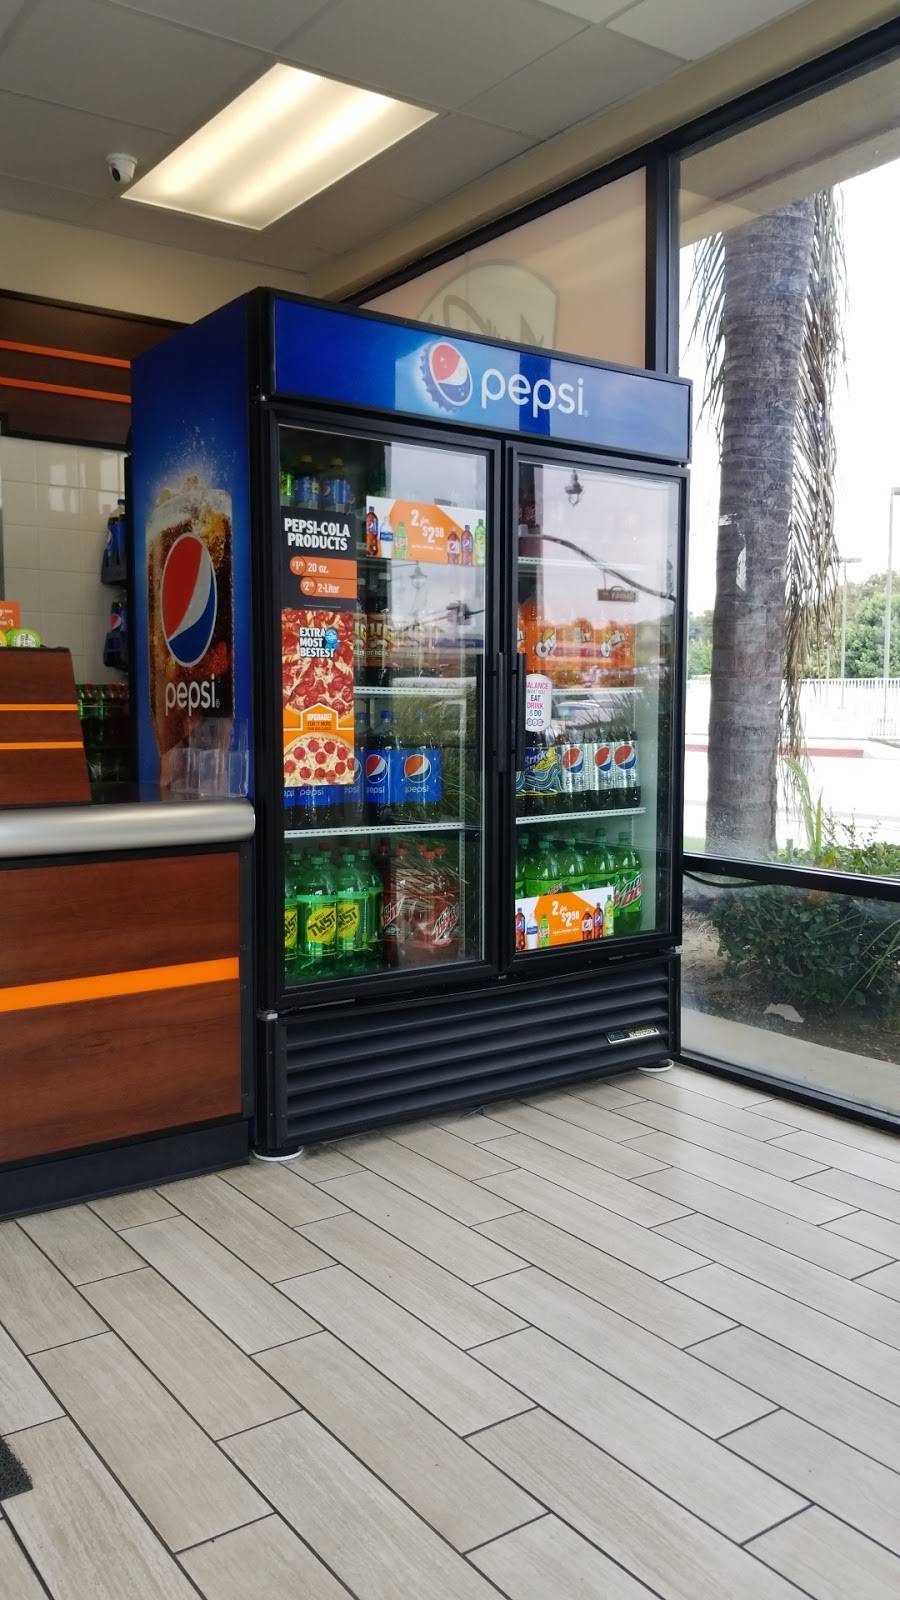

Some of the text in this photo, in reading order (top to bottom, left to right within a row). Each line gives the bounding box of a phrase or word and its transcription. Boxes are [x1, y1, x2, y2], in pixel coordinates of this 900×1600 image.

[481, 368, 585, 418] pepsi
[410, 508, 420, 528] 2
[284, 517, 351, 537] PEPSI-COLA
[287, 532, 348, 551] PRODUCTS
[307, 562, 317, 573] 20
[299, 627, 326, 638] EXTRA
[300, 637, 324, 648] MOST
[300, 648, 335, 658] BESTEST
[526, 681, 549, 690] ALANCE
[165, 672, 215, 717] pepsi
[530, 694, 542, 702] EAT
[527, 702, 545, 710] DRINK
[299, 788, 325, 799] pepsi
[551, 900, 559, 916] 2
